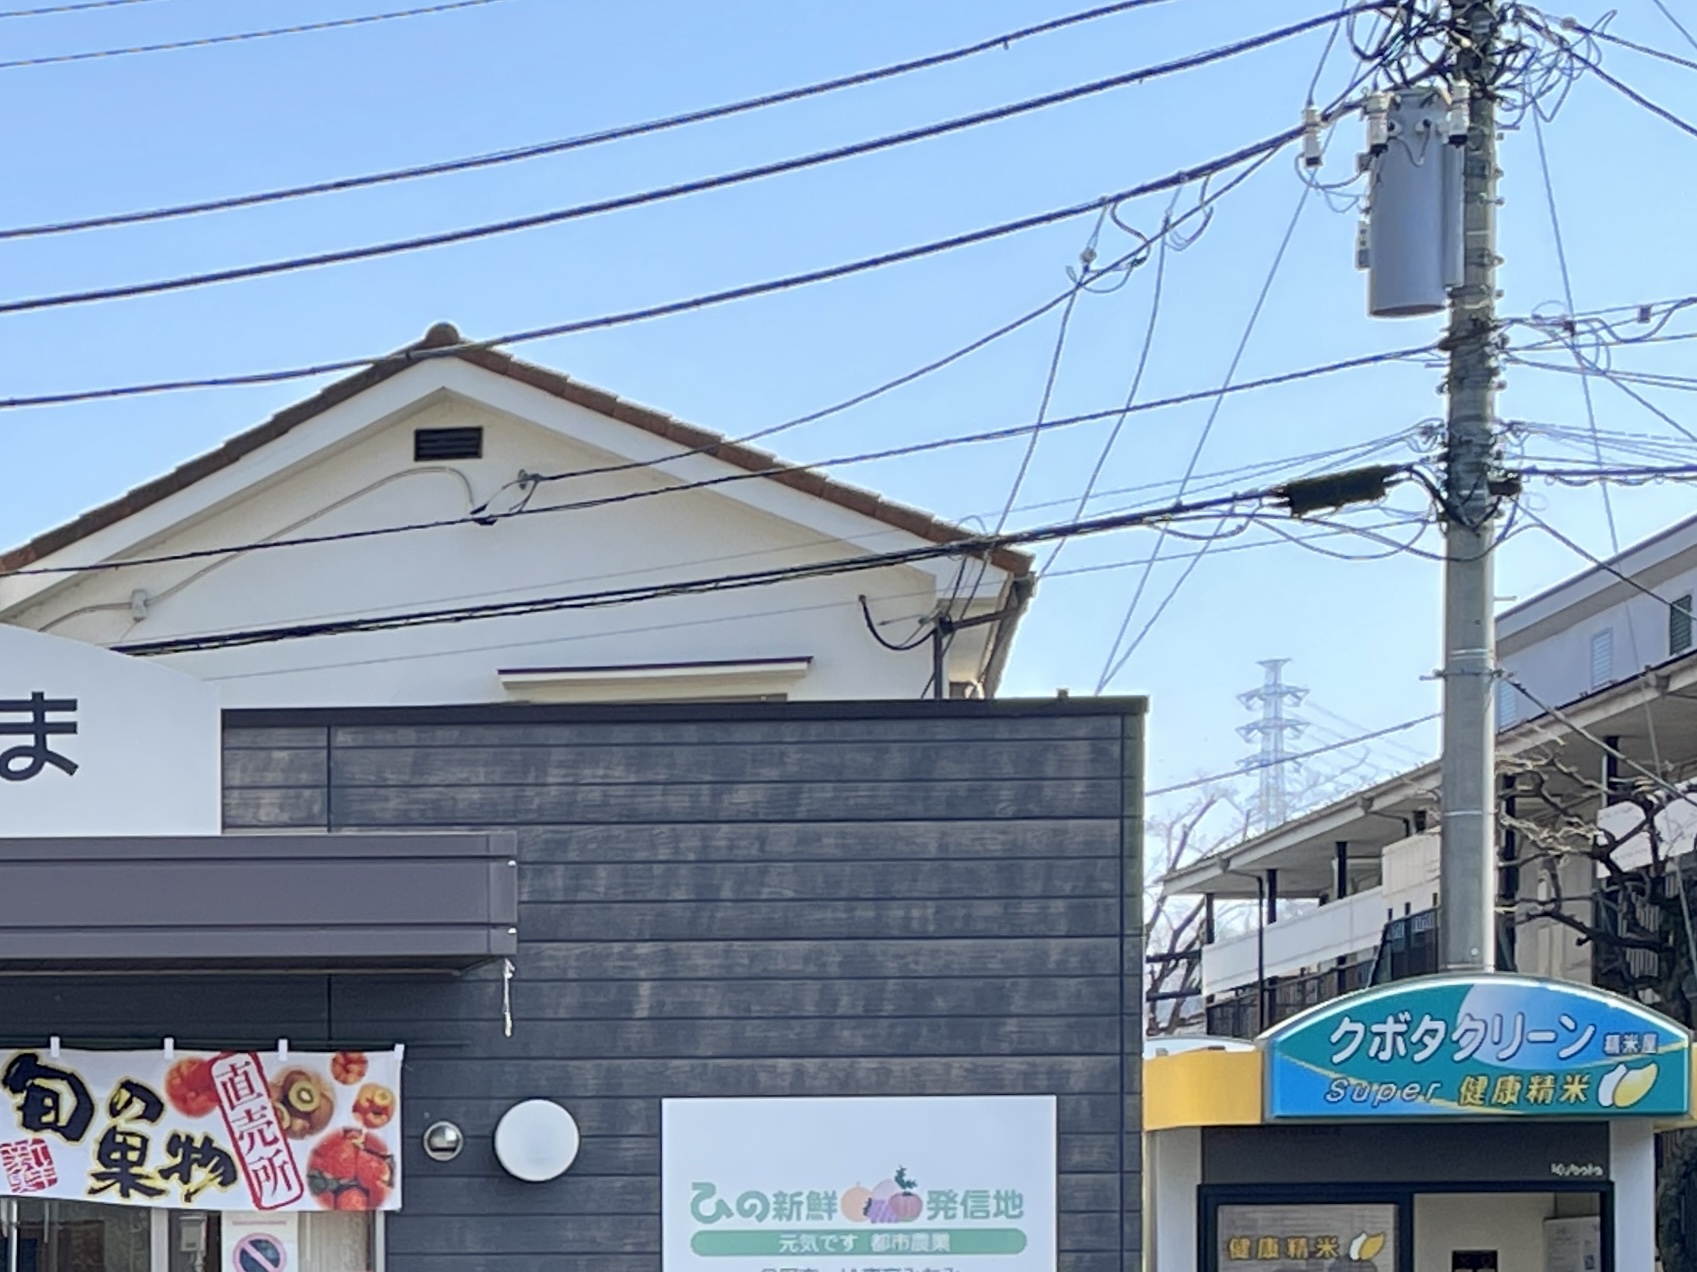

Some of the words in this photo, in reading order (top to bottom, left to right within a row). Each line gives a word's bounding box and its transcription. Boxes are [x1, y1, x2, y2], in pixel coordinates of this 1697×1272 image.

[1329, 1009, 1596, 1065] クボタクリーン
[1325, 1079, 1442, 1107] Super
[1457, 1073, 1590, 1106] 健康精米
[217, 1060, 296, 1200] 直売所
[690, 1180, 838, 1225] ひの新鮮
[926, 1188, 1024, 1221] 発信地
[778, 1233, 859, 1254] 元気です
[1229, 1236, 1339, 1260] 健康精米
